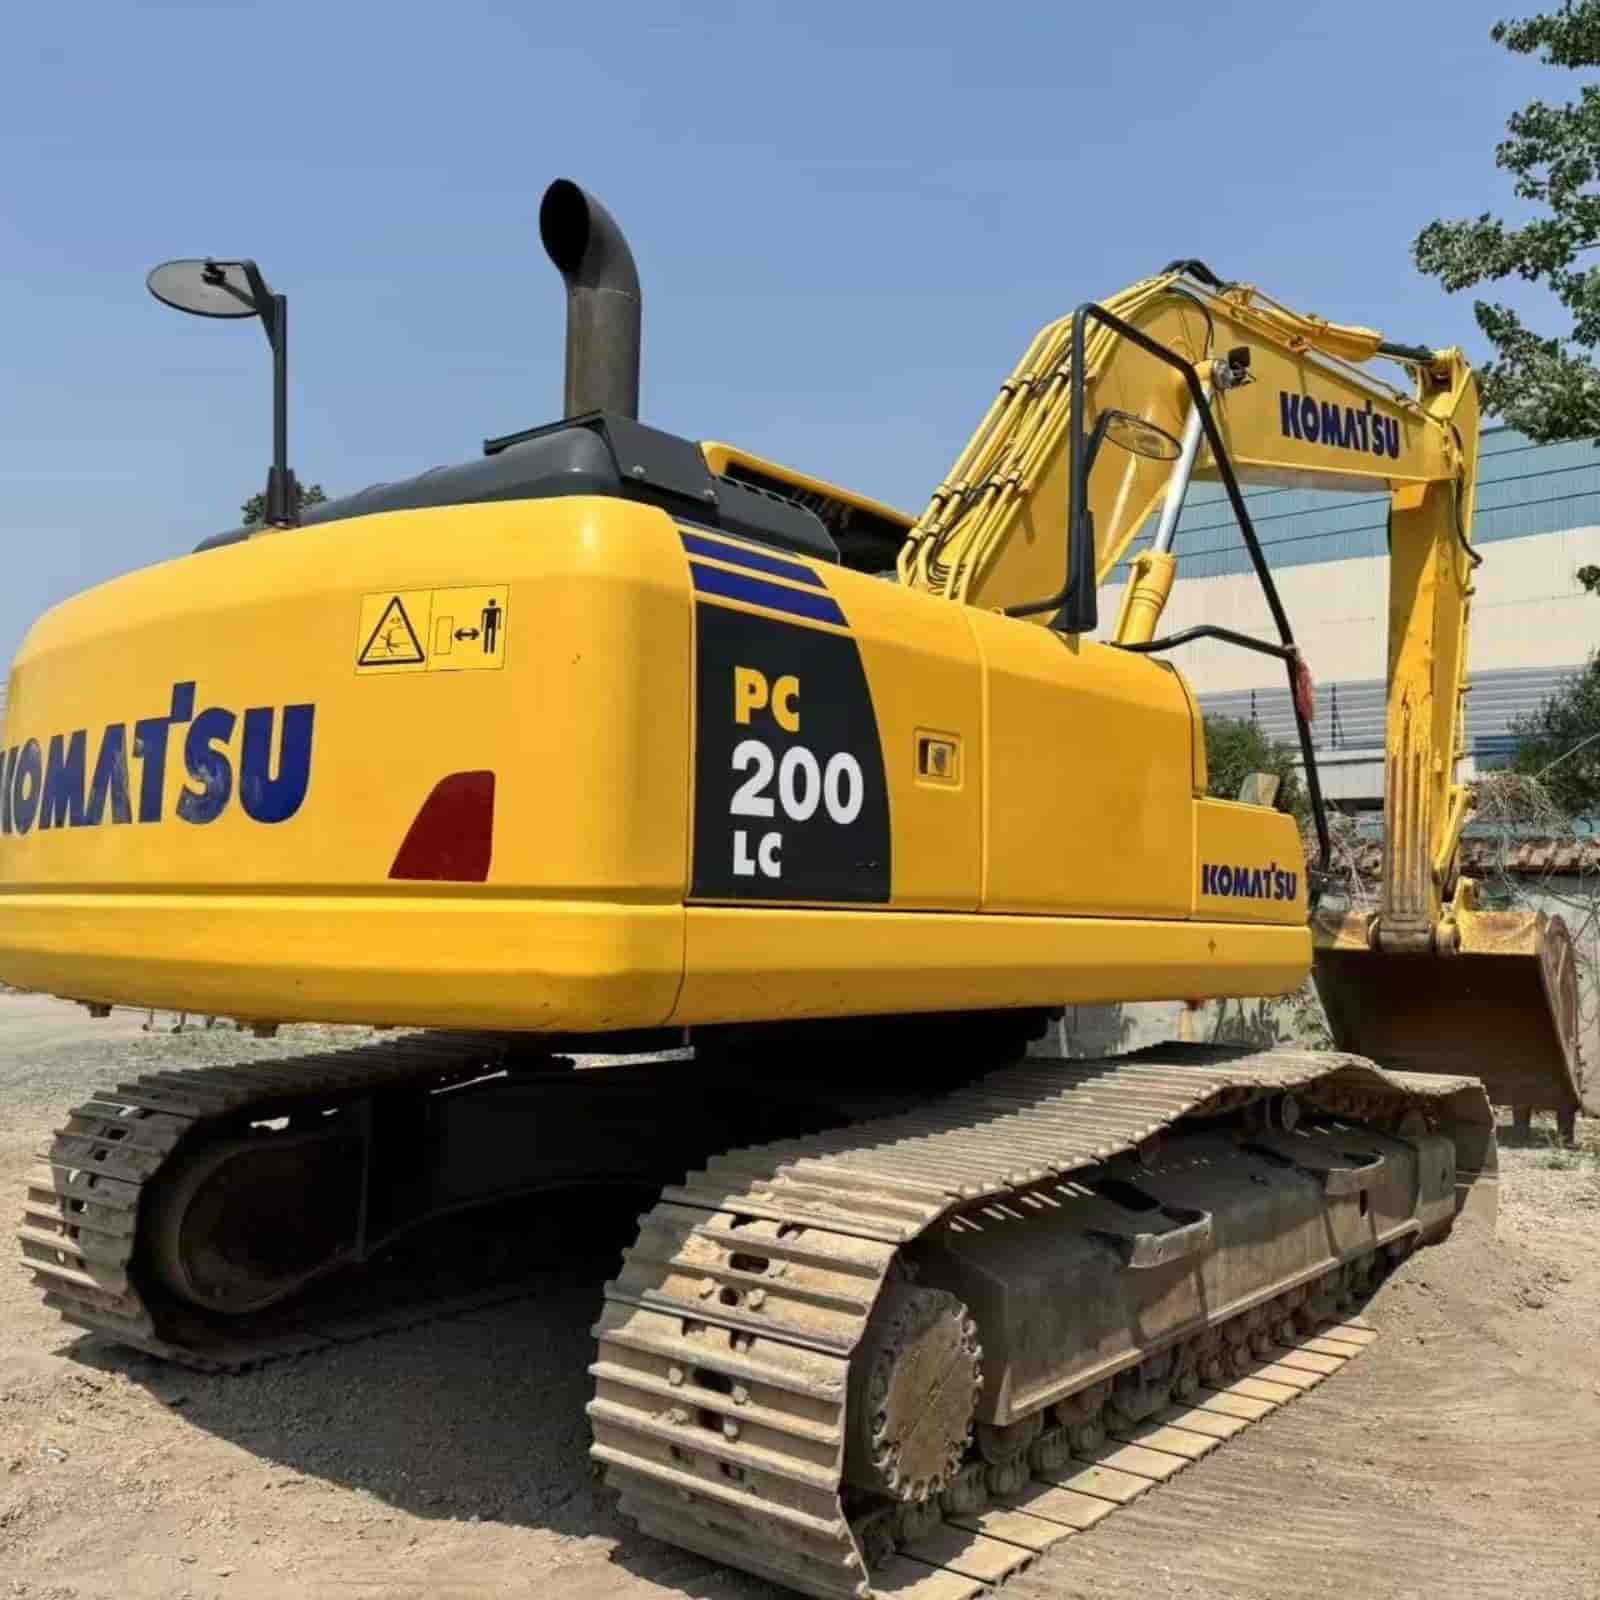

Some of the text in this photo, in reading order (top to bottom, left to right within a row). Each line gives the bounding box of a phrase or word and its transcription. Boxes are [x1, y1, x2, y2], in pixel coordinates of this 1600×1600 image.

[1280, 391, 1400, 459] KOMATSU
[734, 666, 800, 733] PC
[729, 739, 864, 825] 200
[733, 830, 783, 879] LC
[1202, 861, 1297, 900] KOMATSU
